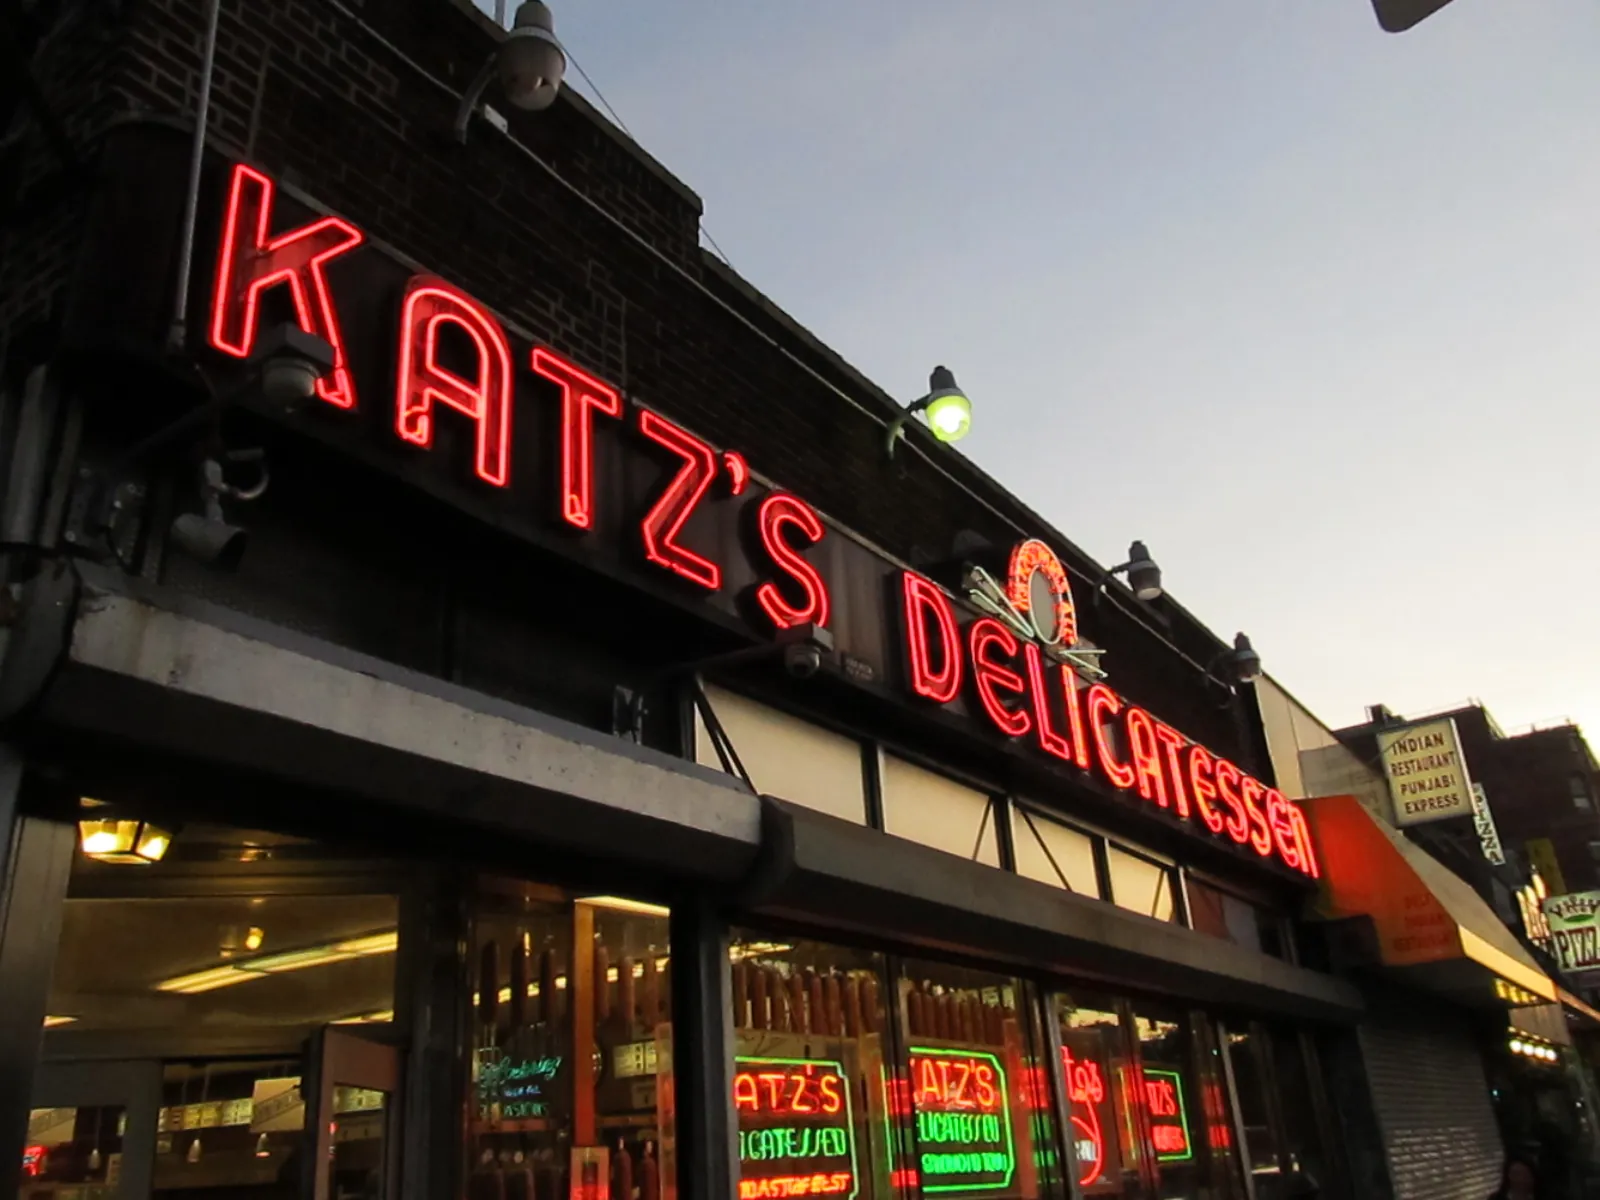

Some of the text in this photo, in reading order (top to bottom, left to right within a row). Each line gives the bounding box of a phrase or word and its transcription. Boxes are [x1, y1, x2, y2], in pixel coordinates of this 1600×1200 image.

[209, 163, 830, 630] KATZ'S
[1391, 731, 1445, 756] INDIAN
[1390, 750, 1456, 777] RESTAURANT
[1400, 773, 1456, 796] PUNJABI
[1404, 792, 1460, 815] EXPRESS
[1553, 925, 1600, 970] PIZZ
[734, 1063, 842, 1113] ATZ'S
